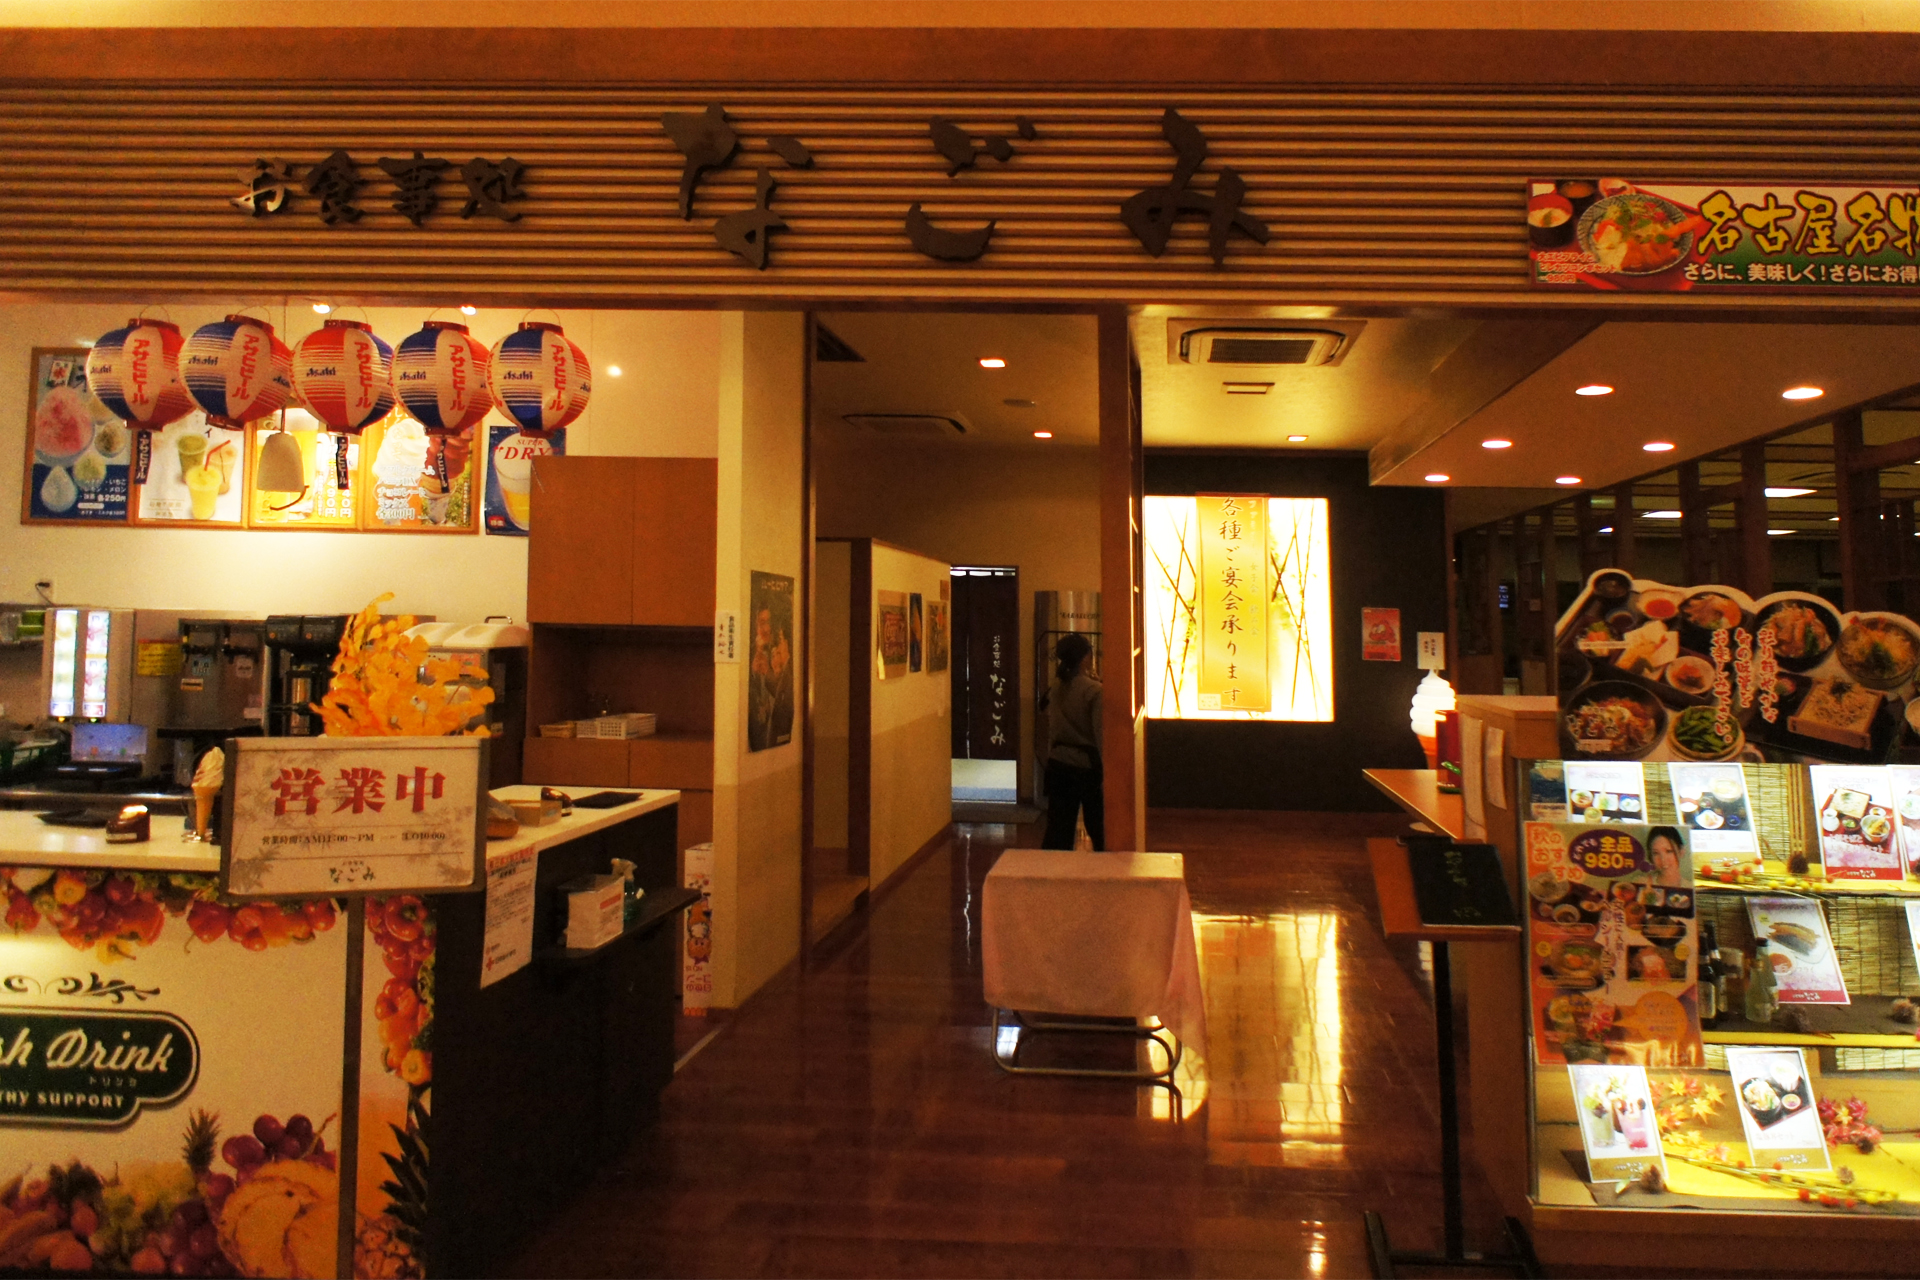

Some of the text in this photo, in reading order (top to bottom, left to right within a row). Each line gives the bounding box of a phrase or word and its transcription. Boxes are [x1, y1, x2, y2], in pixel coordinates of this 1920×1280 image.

[231, 149, 525, 228] お食事処
[1684, 264, 1920, 283] さらに、美味しく!さらにお得
[132, 338, 150, 406] アサヒビール
[187, 354, 219, 366] Asahi
[231, 333, 260, 401] アサヒビール
[305, 366, 337, 378] Asahi
[354, 341, 373, 408] アサヒビール
[399, 370, 427, 381] Asahi
[449, 343, 466, 412] アサヒビール
[503, 370, 534, 381] Asahi
[549, 343, 566, 412] アサヒビール
[1219, 496, 1243, 706] 各種ご宴会承ります
[271, 766, 446, 817] 営業中
[1585, 852, 1635, 870] 980円
[1600, 835, 1634, 854] 全品
[46, 1028, 174, 1072] Drink
[37, 1092, 125, 1108] SUPPORT
